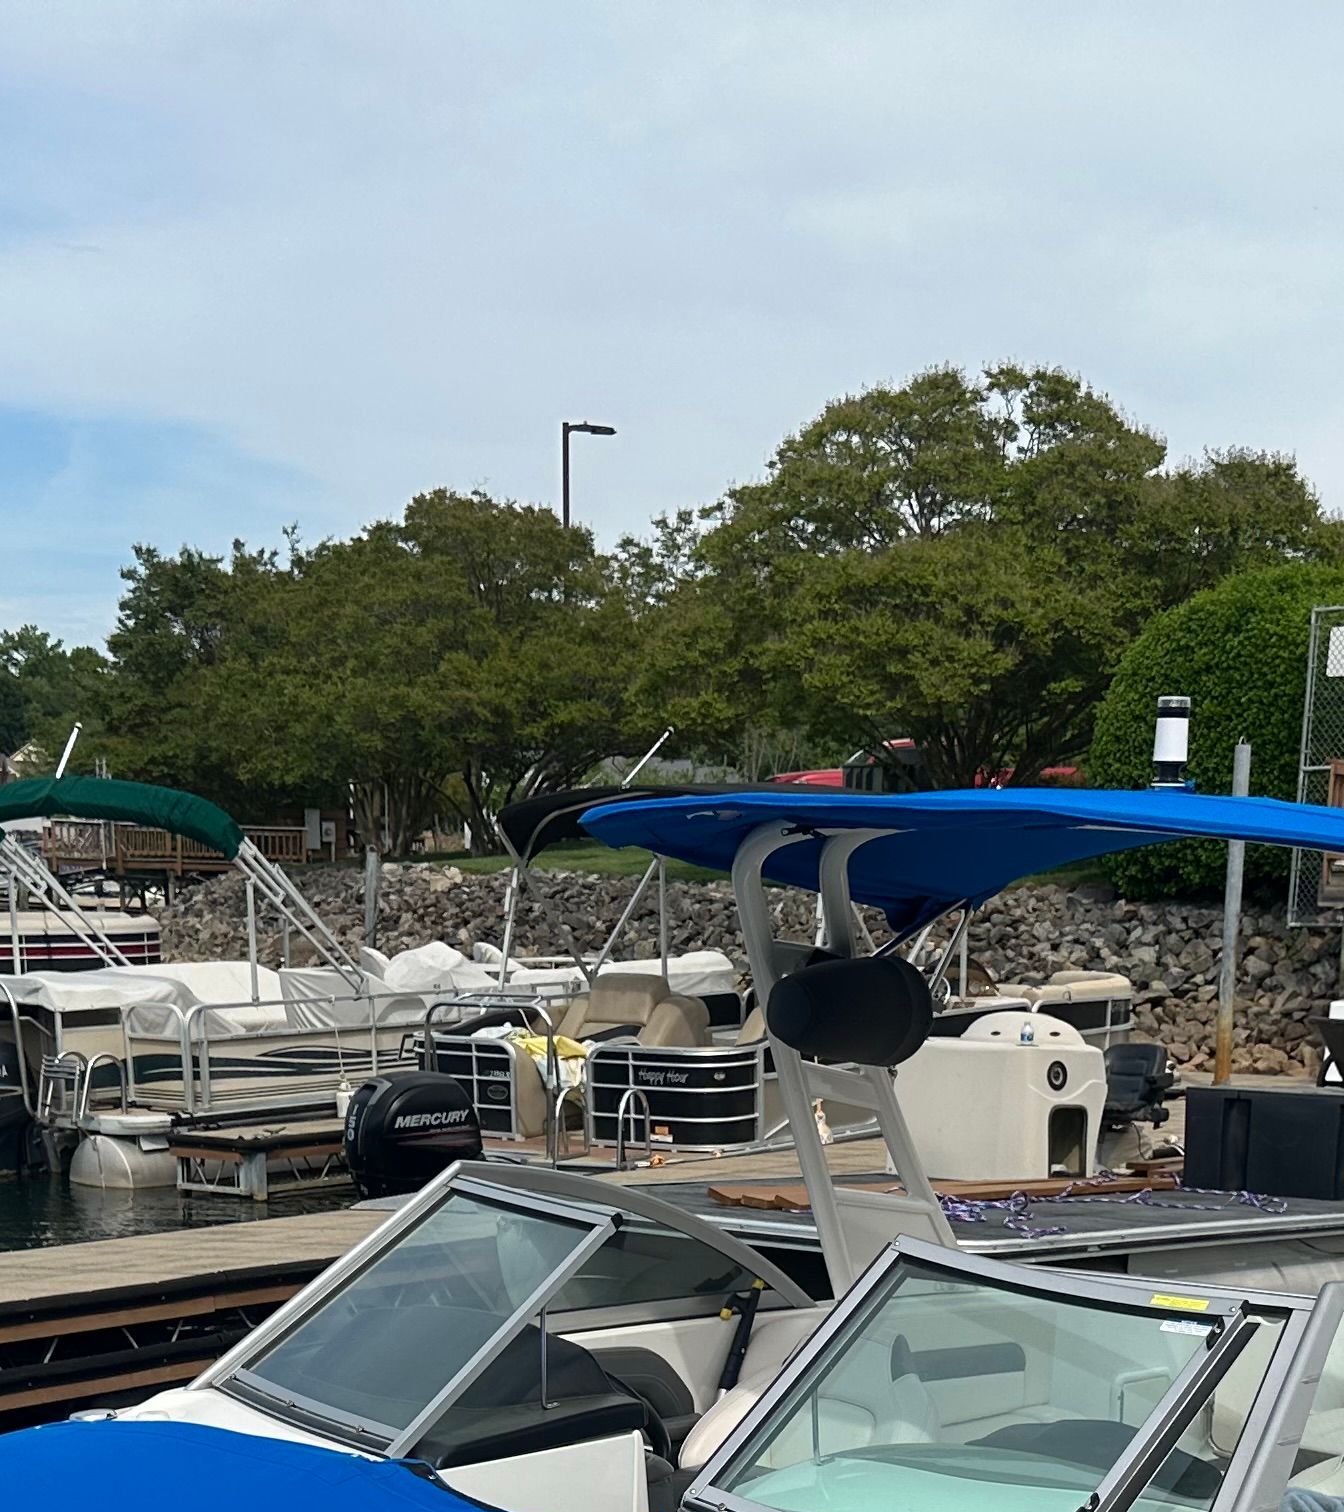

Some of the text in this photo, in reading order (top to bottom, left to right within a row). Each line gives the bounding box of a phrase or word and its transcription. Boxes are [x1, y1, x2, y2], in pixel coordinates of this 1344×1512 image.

[638, 1068, 665, 1085] Happy
[347, 1103, 359, 1141] 150
[394, 1109, 469, 1129] MERCURY
